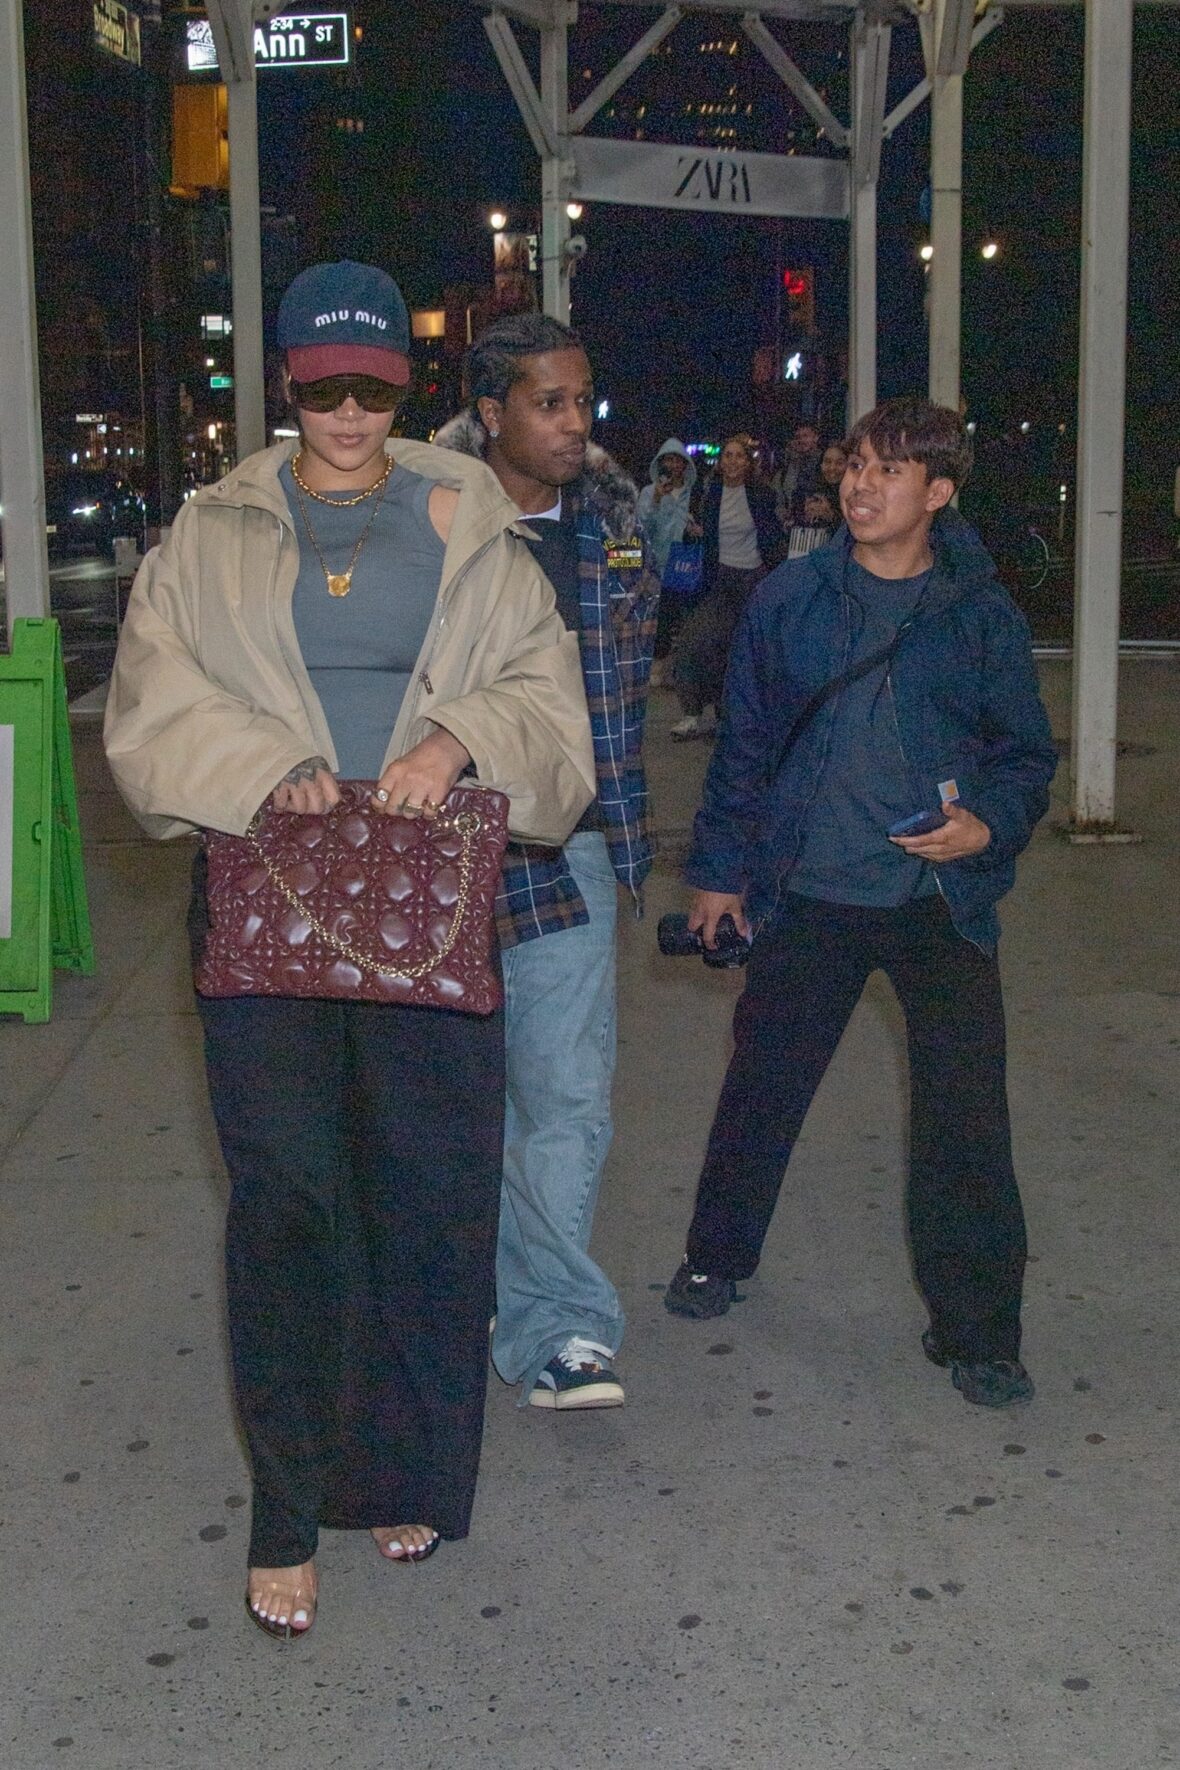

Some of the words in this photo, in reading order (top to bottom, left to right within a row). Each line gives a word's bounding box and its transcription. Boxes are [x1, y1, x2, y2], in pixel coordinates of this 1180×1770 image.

[270, 18, 294, 31] 2-34
[253, 28, 306, 58] Ann
[315, 25, 334, 42] ST
[674, 155, 752, 203] ZARA
